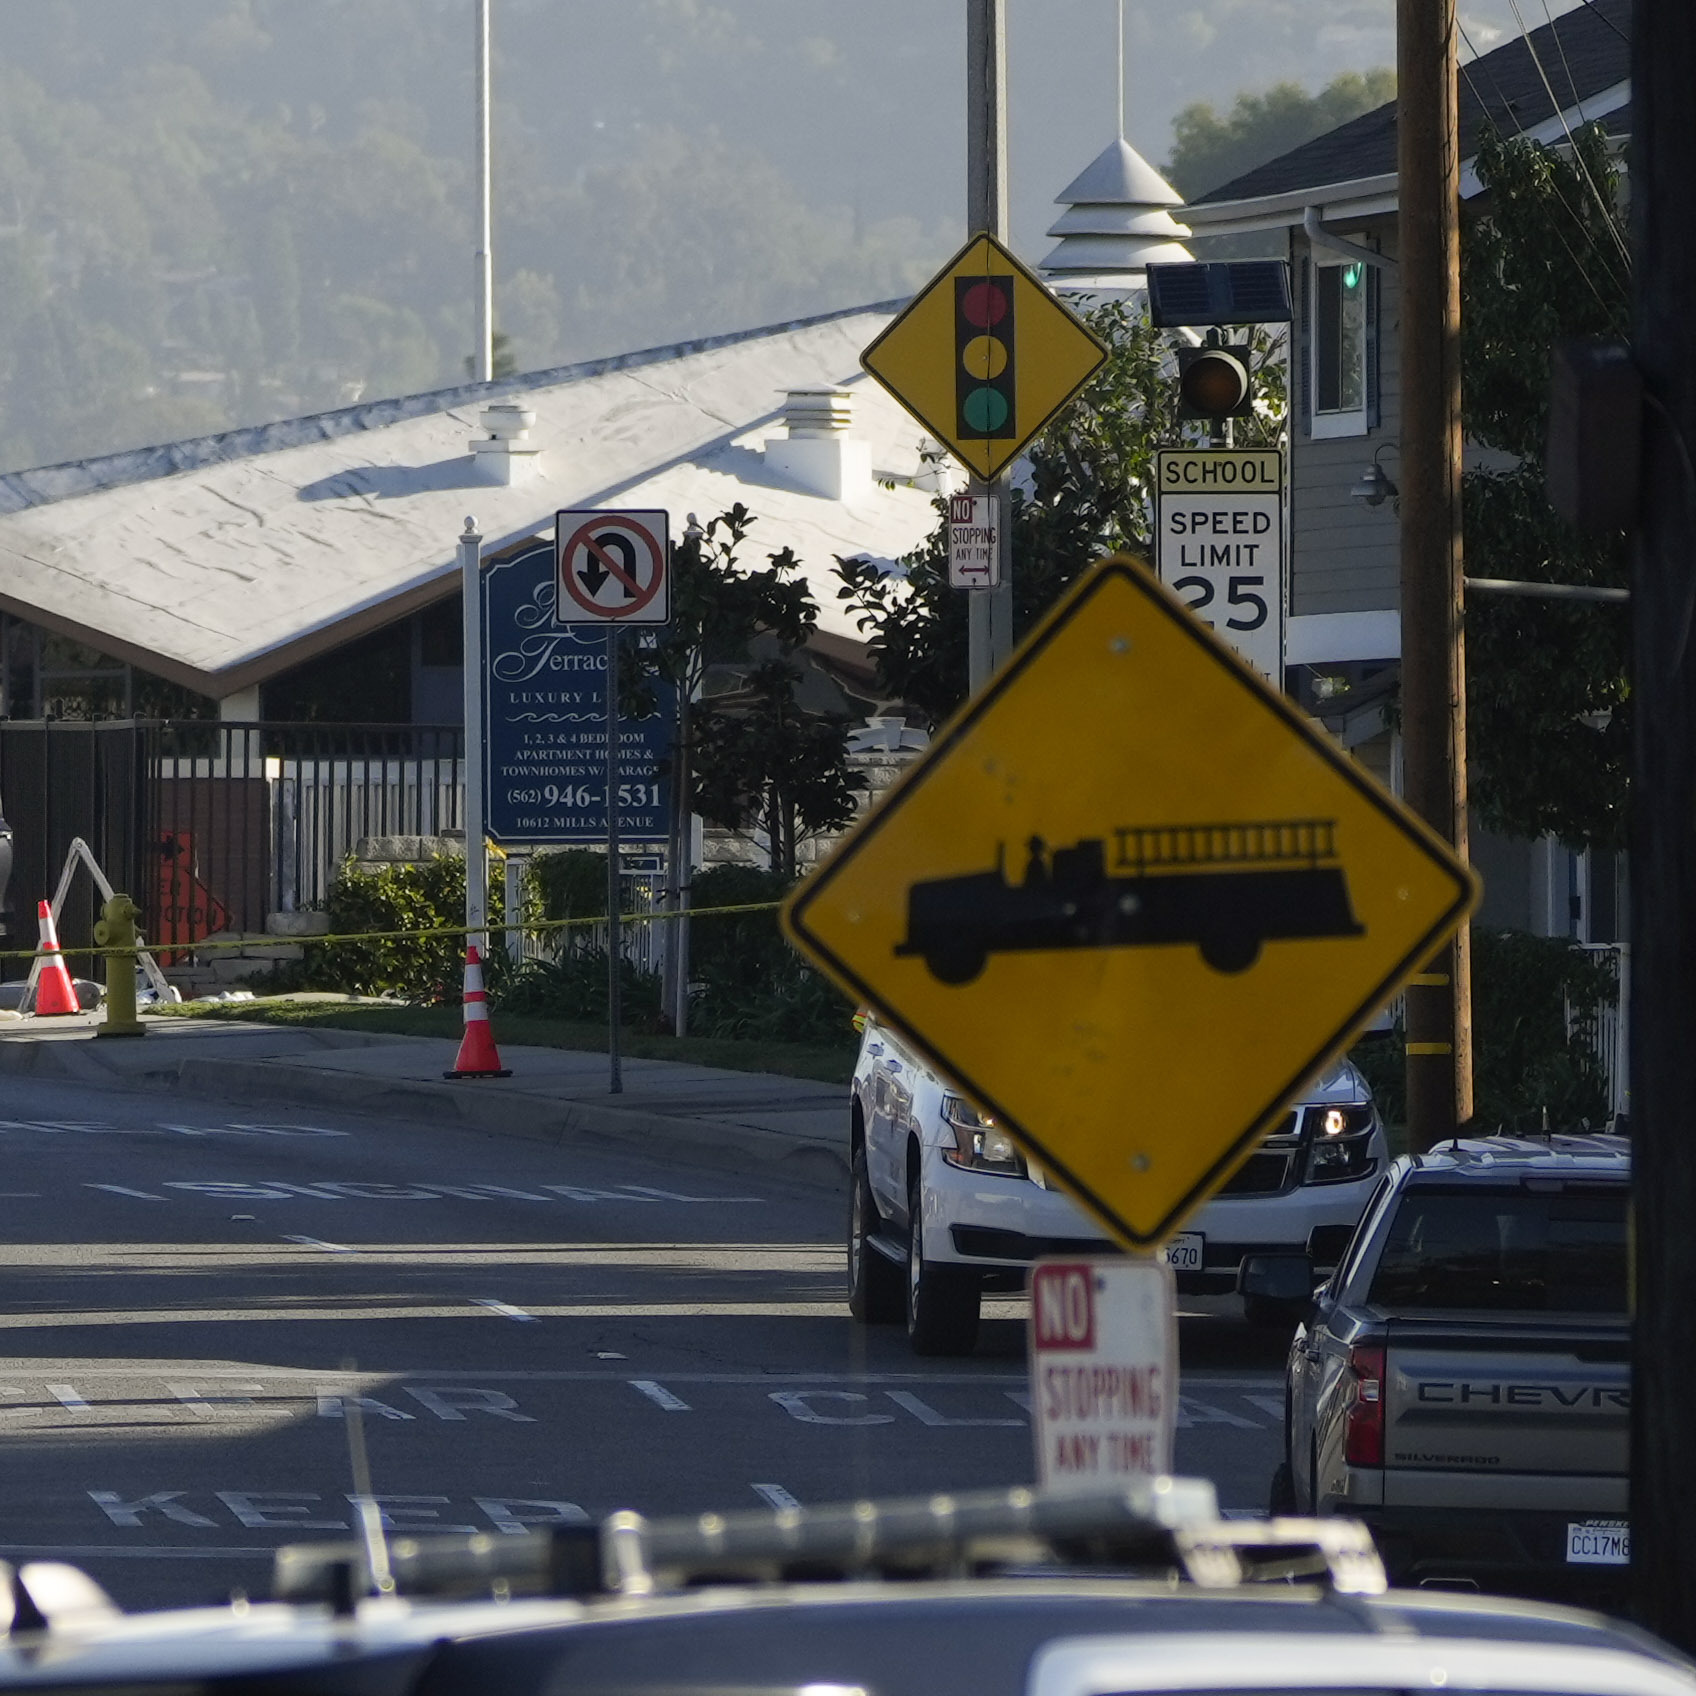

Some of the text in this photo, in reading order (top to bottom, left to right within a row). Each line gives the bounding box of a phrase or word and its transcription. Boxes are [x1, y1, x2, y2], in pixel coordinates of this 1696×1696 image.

[1165, 460, 1275, 484] SCHOOL
[952, 500, 970, 520] NO
[1170, 511, 1271, 535] SPEED
[952, 527, 997, 545] STOPPING
[955, 547, 993, 561] ANY TIME
[1180, 544, 1260, 567] LIMIT
[1171, 576, 1268, 632] 25
[493, 632, 610, 682] Terrac
[510, 692, 583, 704] LUXURY
[547, 733, 554, 744] 3
[557, 733, 567, 744] &
[570, 733, 577, 744] 4
[580, 733, 645, 744] BEDOM
[514, 749, 592, 760] APARTMENT
[644, 749, 654, 760] &
[501, 766, 586, 776] TOWNHOMES
[588, 766, 604, 776] W/
[507, 788, 541, 805] (562)
[516, 817, 654, 828] 10612 MILLS AENUE
[1039, 1273, 1088, 1342] NO
[1046, 1365, 1160, 1421] STOPPING
[1056, 1430, 1156, 1476] ANY TIME
[1395, 1452, 1501, 1465] SILVERADO
[87, 1489, 590, 1535] KEEP
